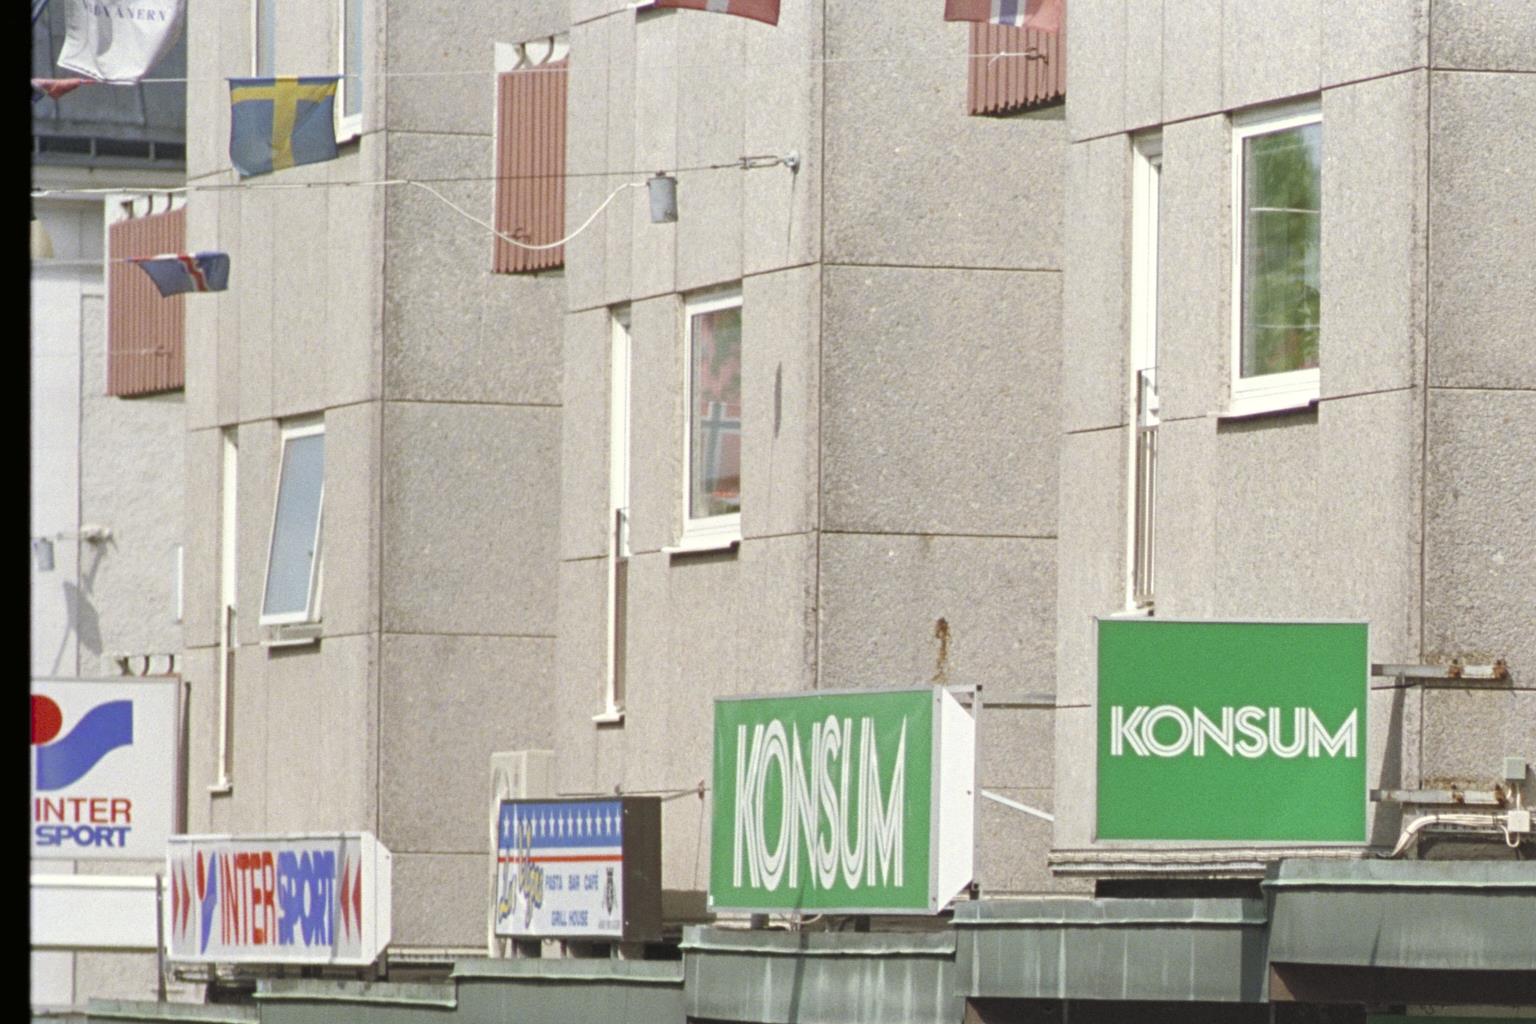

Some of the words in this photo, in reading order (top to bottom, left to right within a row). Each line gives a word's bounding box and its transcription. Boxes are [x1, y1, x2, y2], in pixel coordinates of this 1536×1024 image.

[1110, 704, 1358, 758] KONSUM
[35, 798, 132, 823] INTER
[733, 713, 907, 891] KONSUM
[35, 825, 132, 847] SPORT
